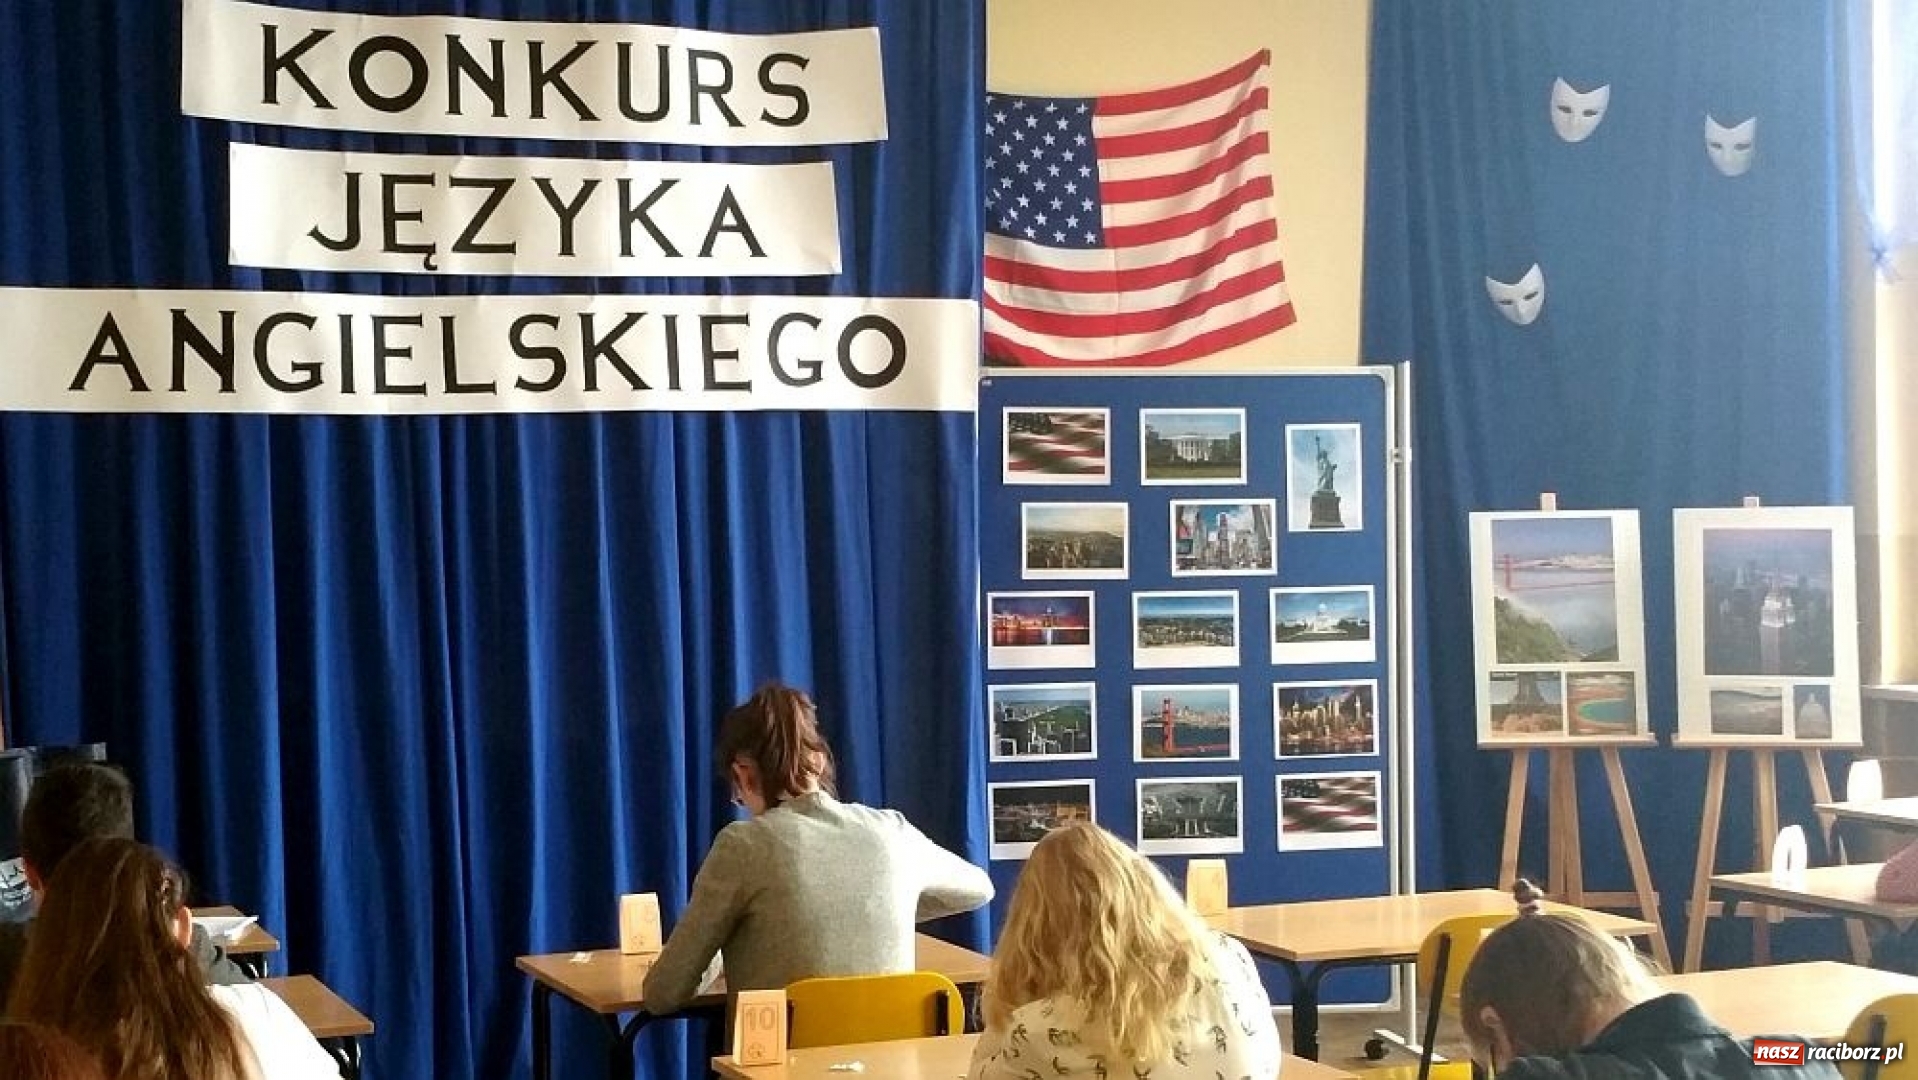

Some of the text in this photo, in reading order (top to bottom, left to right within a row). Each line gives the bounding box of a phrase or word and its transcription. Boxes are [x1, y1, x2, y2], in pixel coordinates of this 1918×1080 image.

[260, 24, 811, 127] KONKURS
[306, 171, 768, 271] JĘZYKA
[68, 308, 908, 396] ANGIELSKIEGO
[745, 1006, 776, 1031] 10
